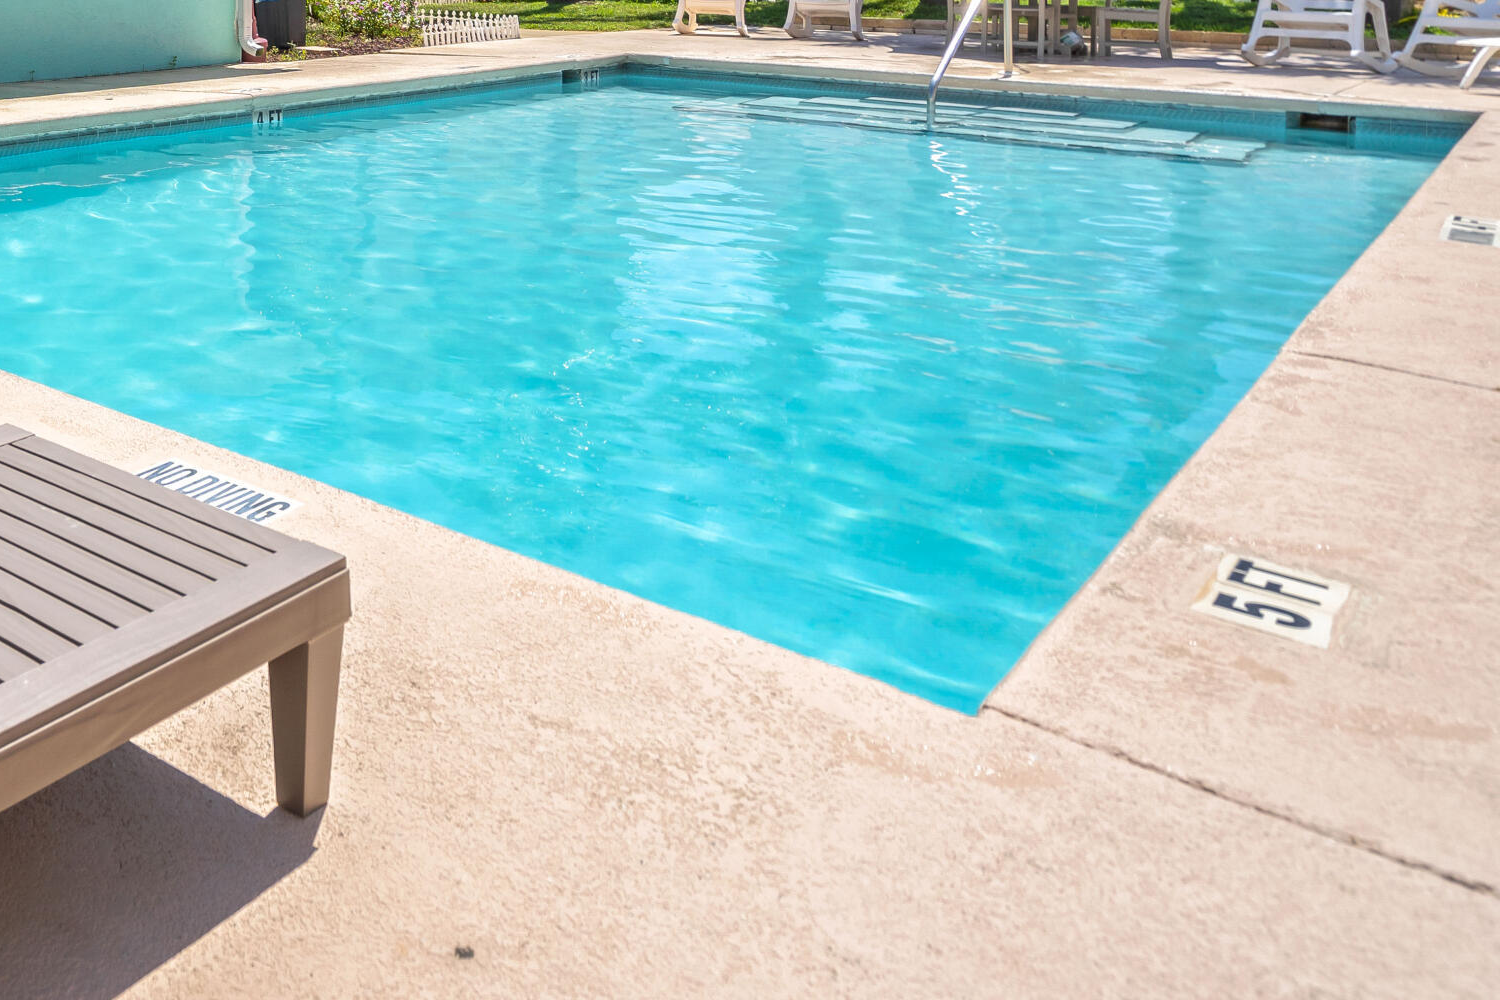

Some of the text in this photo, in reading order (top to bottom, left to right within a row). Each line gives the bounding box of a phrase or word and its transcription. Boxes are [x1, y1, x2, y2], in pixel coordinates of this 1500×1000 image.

[269, 109, 282, 123] FT
[136, 461, 290, 522] NO DIVING
[1212, 558, 1329, 629] 5 FT
